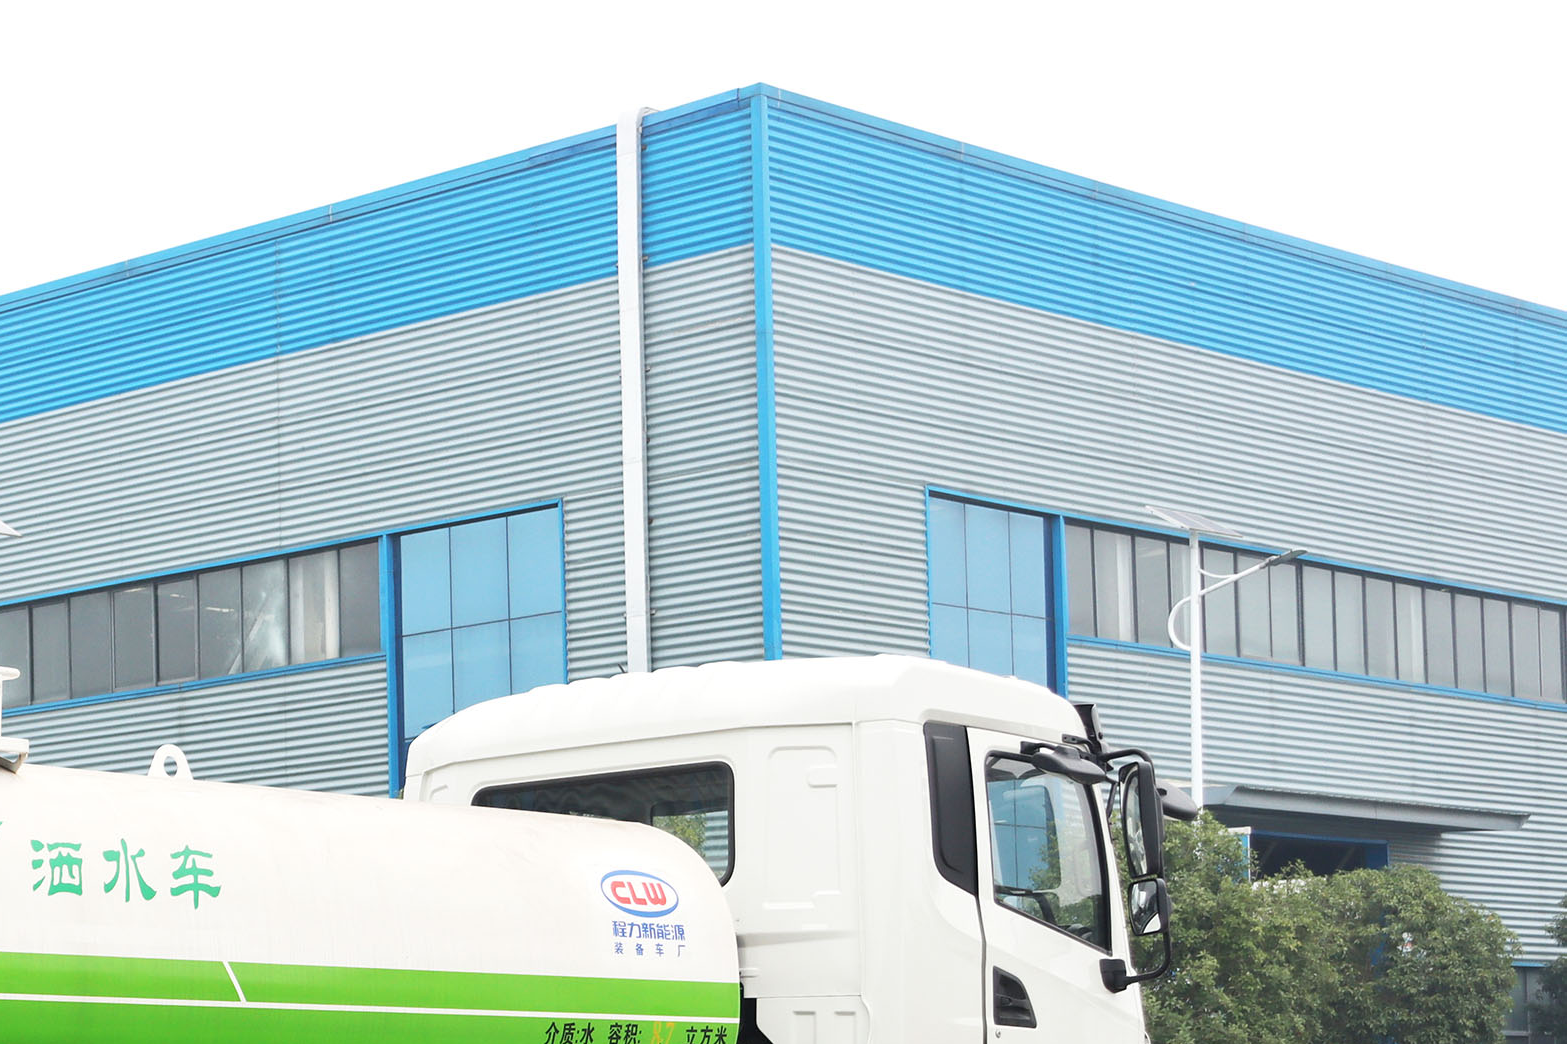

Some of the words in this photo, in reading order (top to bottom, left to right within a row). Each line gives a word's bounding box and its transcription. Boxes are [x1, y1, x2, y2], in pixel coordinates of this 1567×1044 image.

[30, 838, 222, 910] 洒水车
[610, 880, 667, 906] CLW
[612, 920, 686, 941] 程力新能源
[614, 942, 686, 957] 装备车厂
